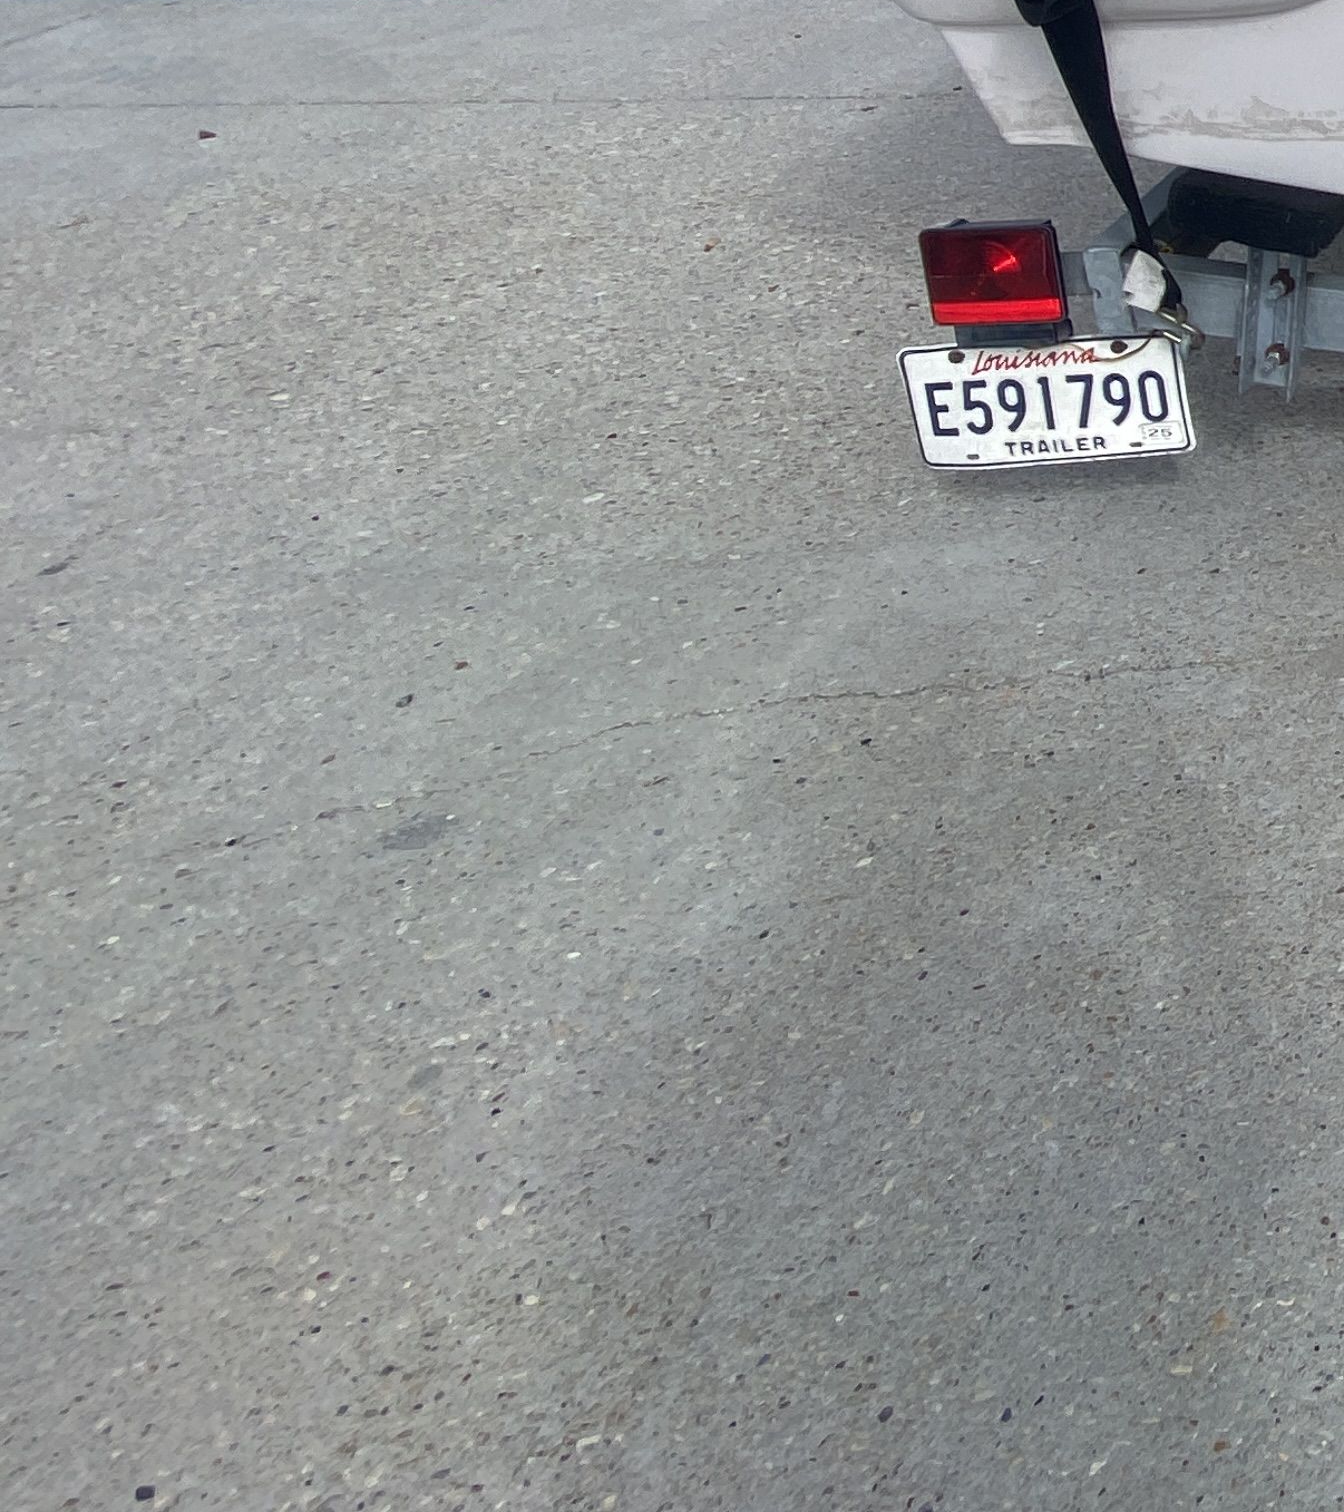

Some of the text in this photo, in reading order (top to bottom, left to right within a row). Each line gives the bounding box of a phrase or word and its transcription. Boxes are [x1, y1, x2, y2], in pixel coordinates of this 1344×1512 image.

[971, 347, 1100, 375] Louisiana
[924, 370, 1170, 437] E591790
[1147, 428, 1173, 439] 25
[1004, 436, 1107, 457] TRAILER
